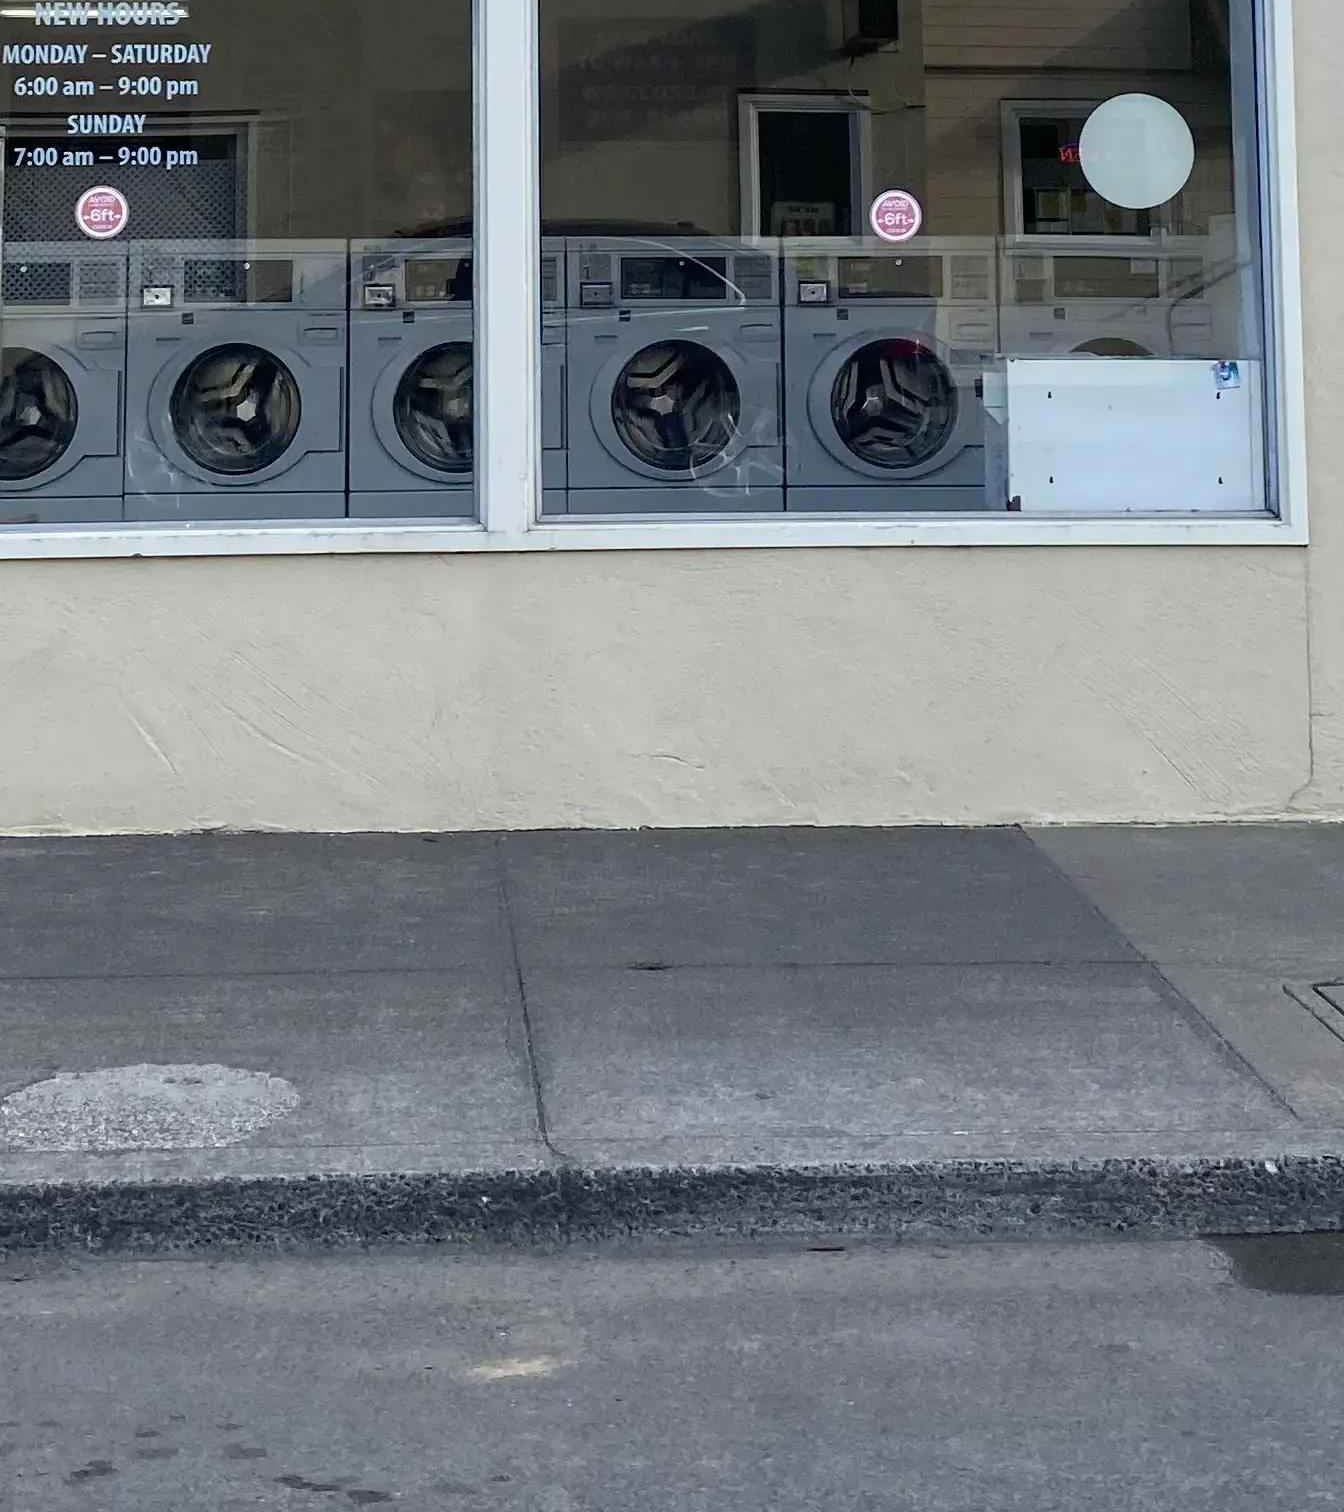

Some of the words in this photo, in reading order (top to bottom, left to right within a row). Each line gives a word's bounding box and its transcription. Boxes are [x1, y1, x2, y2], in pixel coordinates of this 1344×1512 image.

[35, 1, 91, 26] NEW
[97, 1, 181, 26] HOURS
[2, 43, 87, 65] MONDAY
[111, 43, 212, 65] SATURDAY
[13, 76, 57, 96] 6:00
[64, 80, 95, 96] am
[118, 76, 162, 96] 9:00
[166, 80, 199, 100] pm
[67, 114, 147, 135] SUNDAY
[13, 147, 58, 167] 7:00
[62, 151, 94, 167] am
[118, 146, 162, 166] 9:00
[166, 150, 198, 170] pm
[90, 208, 115, 222] 6ft
[884, 212, 908, 226] 6ft
